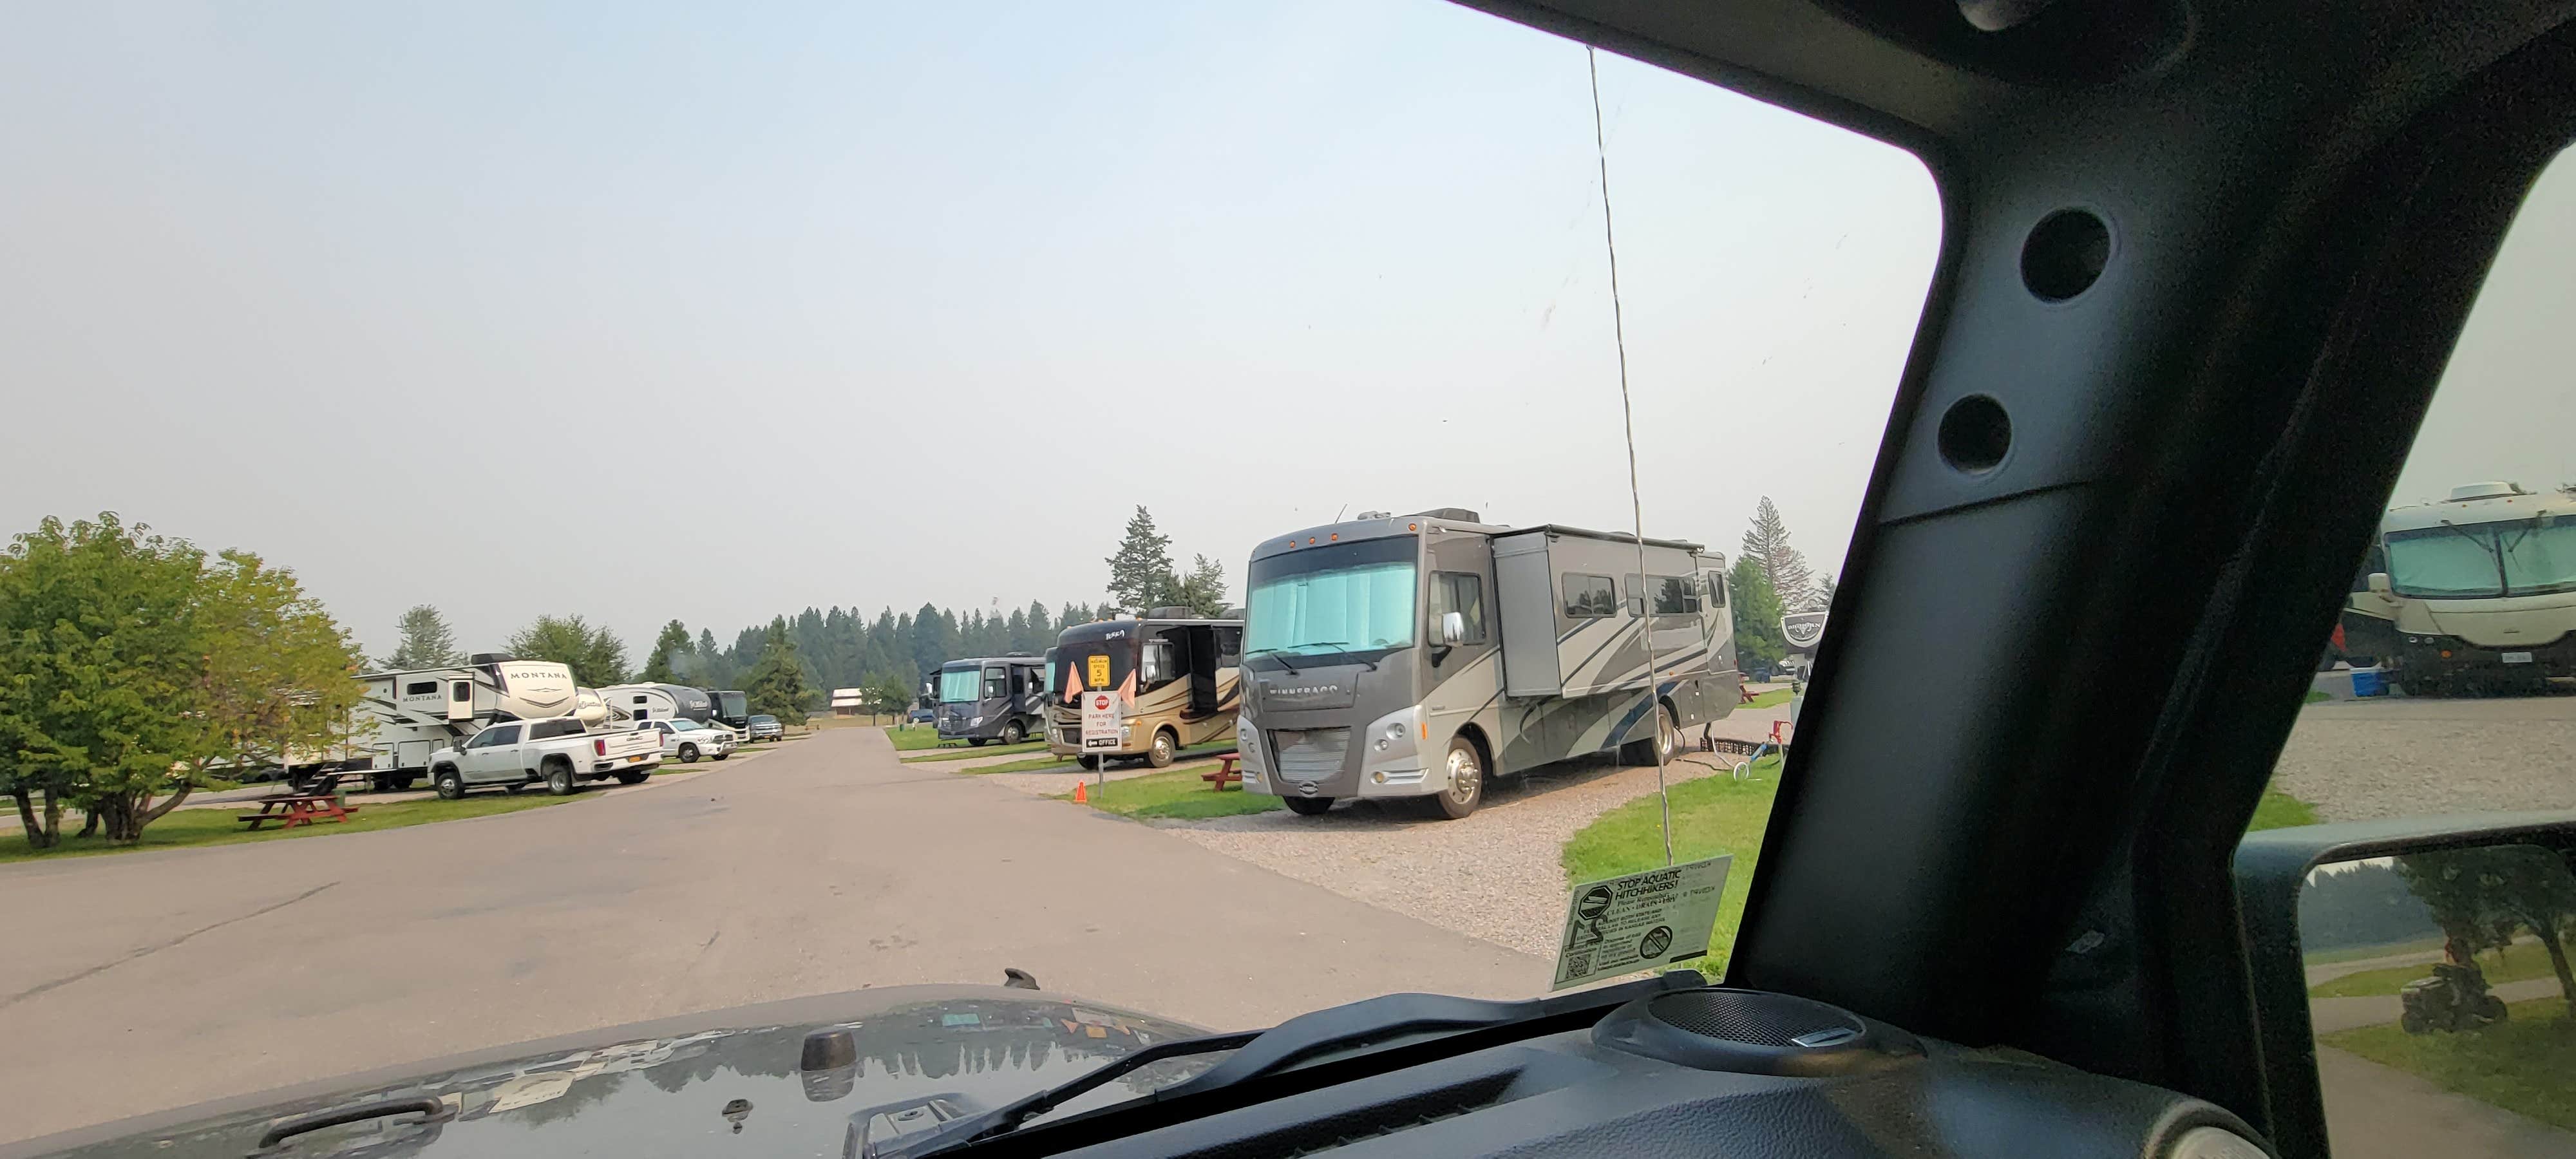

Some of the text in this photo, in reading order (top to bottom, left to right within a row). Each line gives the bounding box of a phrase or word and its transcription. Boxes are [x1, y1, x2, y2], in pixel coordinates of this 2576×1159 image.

[1615, 880, 1678, 900] HITCHHIKERS!
[1617, 870, 1682, 890] STOP AQUATIC
